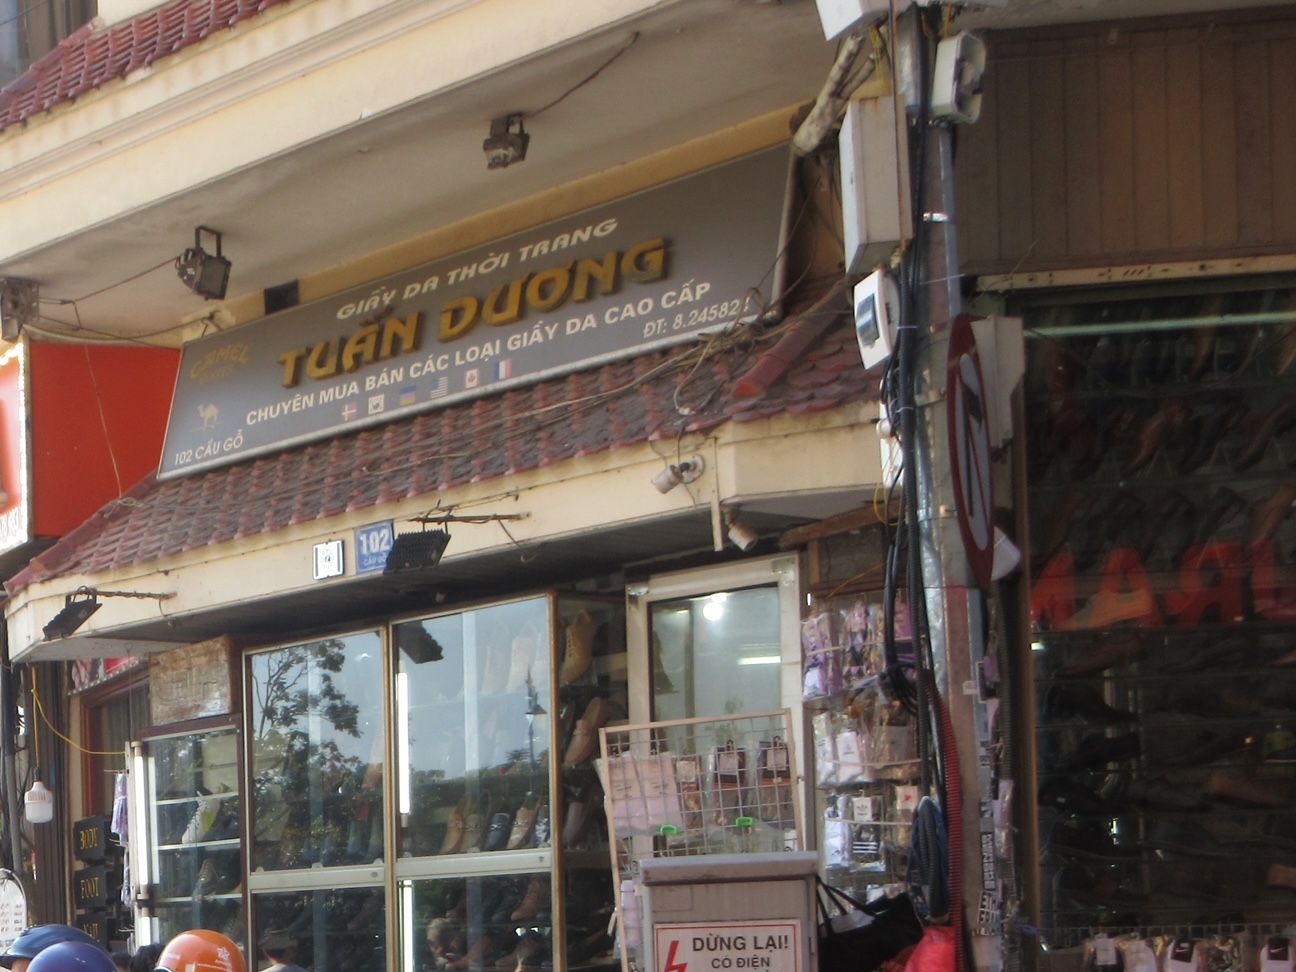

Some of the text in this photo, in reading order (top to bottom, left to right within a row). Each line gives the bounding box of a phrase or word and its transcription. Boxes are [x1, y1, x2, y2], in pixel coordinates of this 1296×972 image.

[403, 275, 439, 299] DA
[519, 218, 618, 262] TRANG
[438, 236, 668, 343] DƯƠNG
[246, 394, 314, 425] CHUYÊN
[319, 384, 359, 407] MUA
[364, 366, 403, 393] BÁN
[409, 356, 448, 379] CÁC
[454, 339, 501, 366] LOẠI
[565, 312, 597, 335] DA
[604, 298, 654, 325] CAO
[661, 278, 711, 309] CẤP
[360, 527, 390, 555] 102
[693, 932, 789, 953] DỪNG LẠI!
[711, 954, 771, 970] CÓ ĐIỆN
